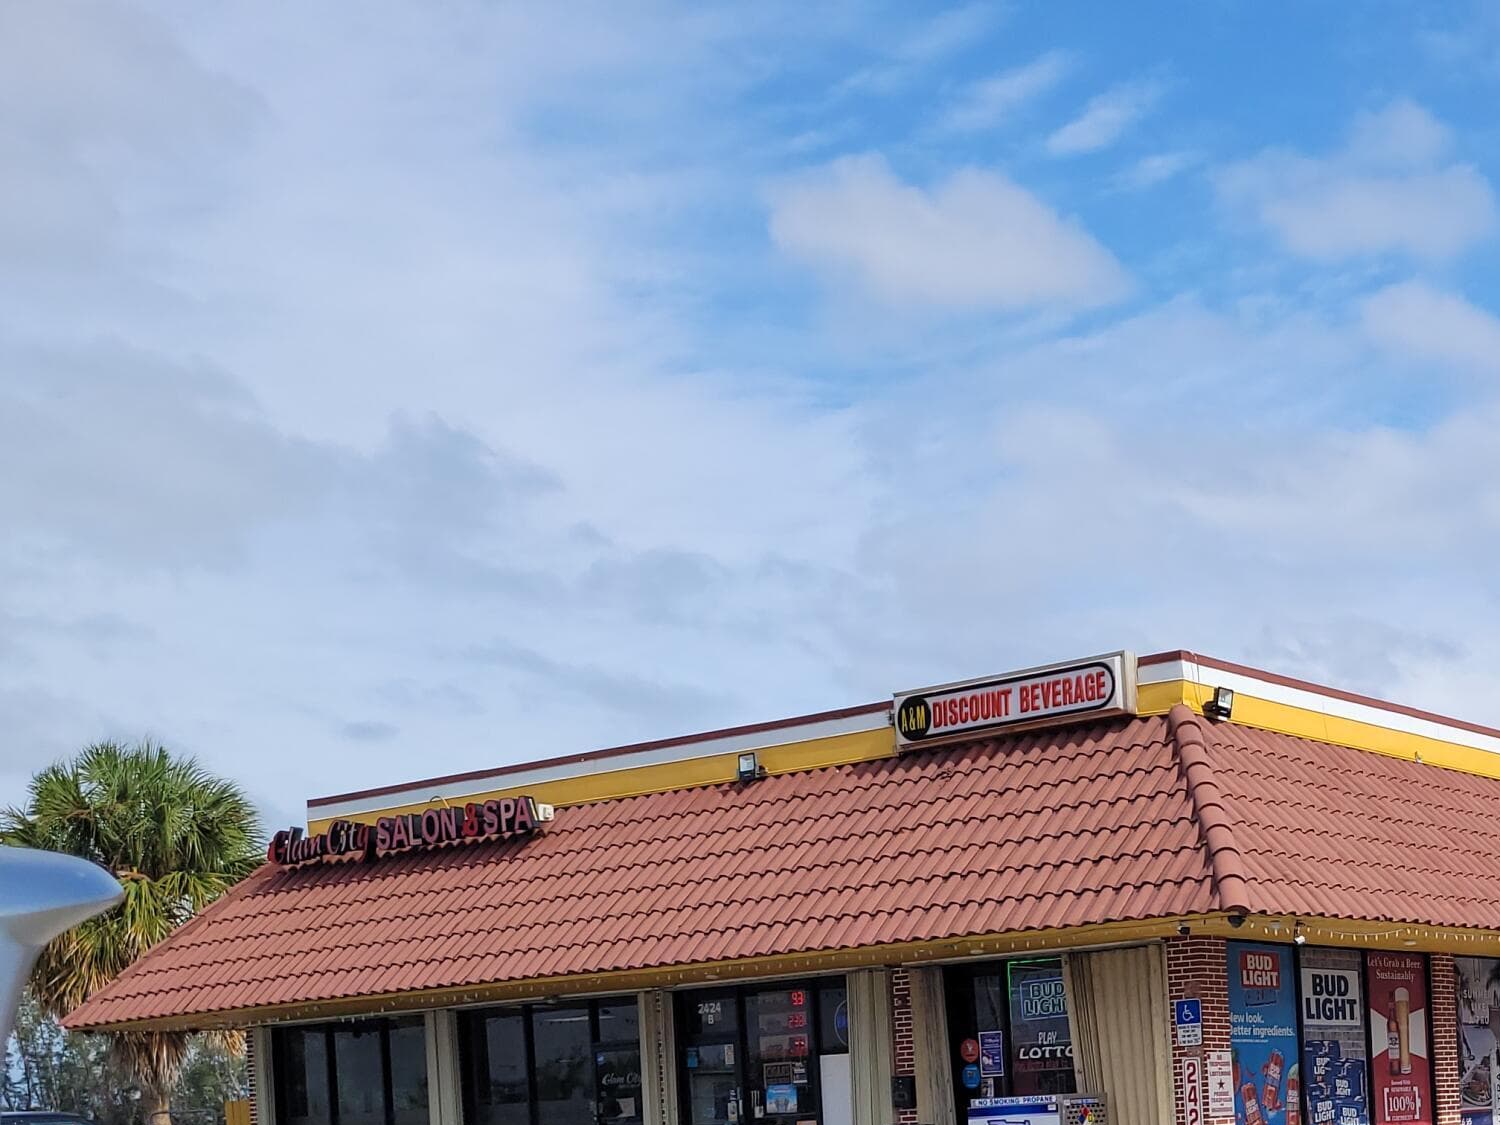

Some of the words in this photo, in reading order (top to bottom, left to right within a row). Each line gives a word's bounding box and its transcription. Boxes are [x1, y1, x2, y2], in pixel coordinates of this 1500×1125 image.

[901, 706, 926, 734] A&M
[933, 687, 1013, 729] DISCOUNT
[1019, 671, 1106, 714] BEVERAGE
[376, 806, 456, 851] SALON
[462, 802, 479, 837] &
[483, 796, 534, 835] SPA
[1246, 954, 1273, 971] BUD
[1242, 969, 1278, 987] LIGHT
[1376, 969, 1415, 984] Sustainably
[1029, 982, 1065, 999] BUD
[1311, 973, 1350, 997] BUD
[698, 1002, 721, 1014] 2424
[1024, 998, 1068, 1016] LIGH
[1305, 997, 1357, 1021] LIGHT
[708, 1014, 714, 1025] B
[1245, 1012, 1265, 1024] look.
[1038, 1031, 1057, 1045] PLAY
[1252, 1024, 1296, 1039] ingredients.
[1336, 1079, 1349, 1088] BUD
[1023, 1095, 1053, 1103] PROPANE
[1317, 1101, 1333, 1112] BUD
[1389, 1096, 1415, 1112] 100%
[1315, 1110, 1336, 1123] LIGHT
[1342, 1107, 1358, 1117] BUD
